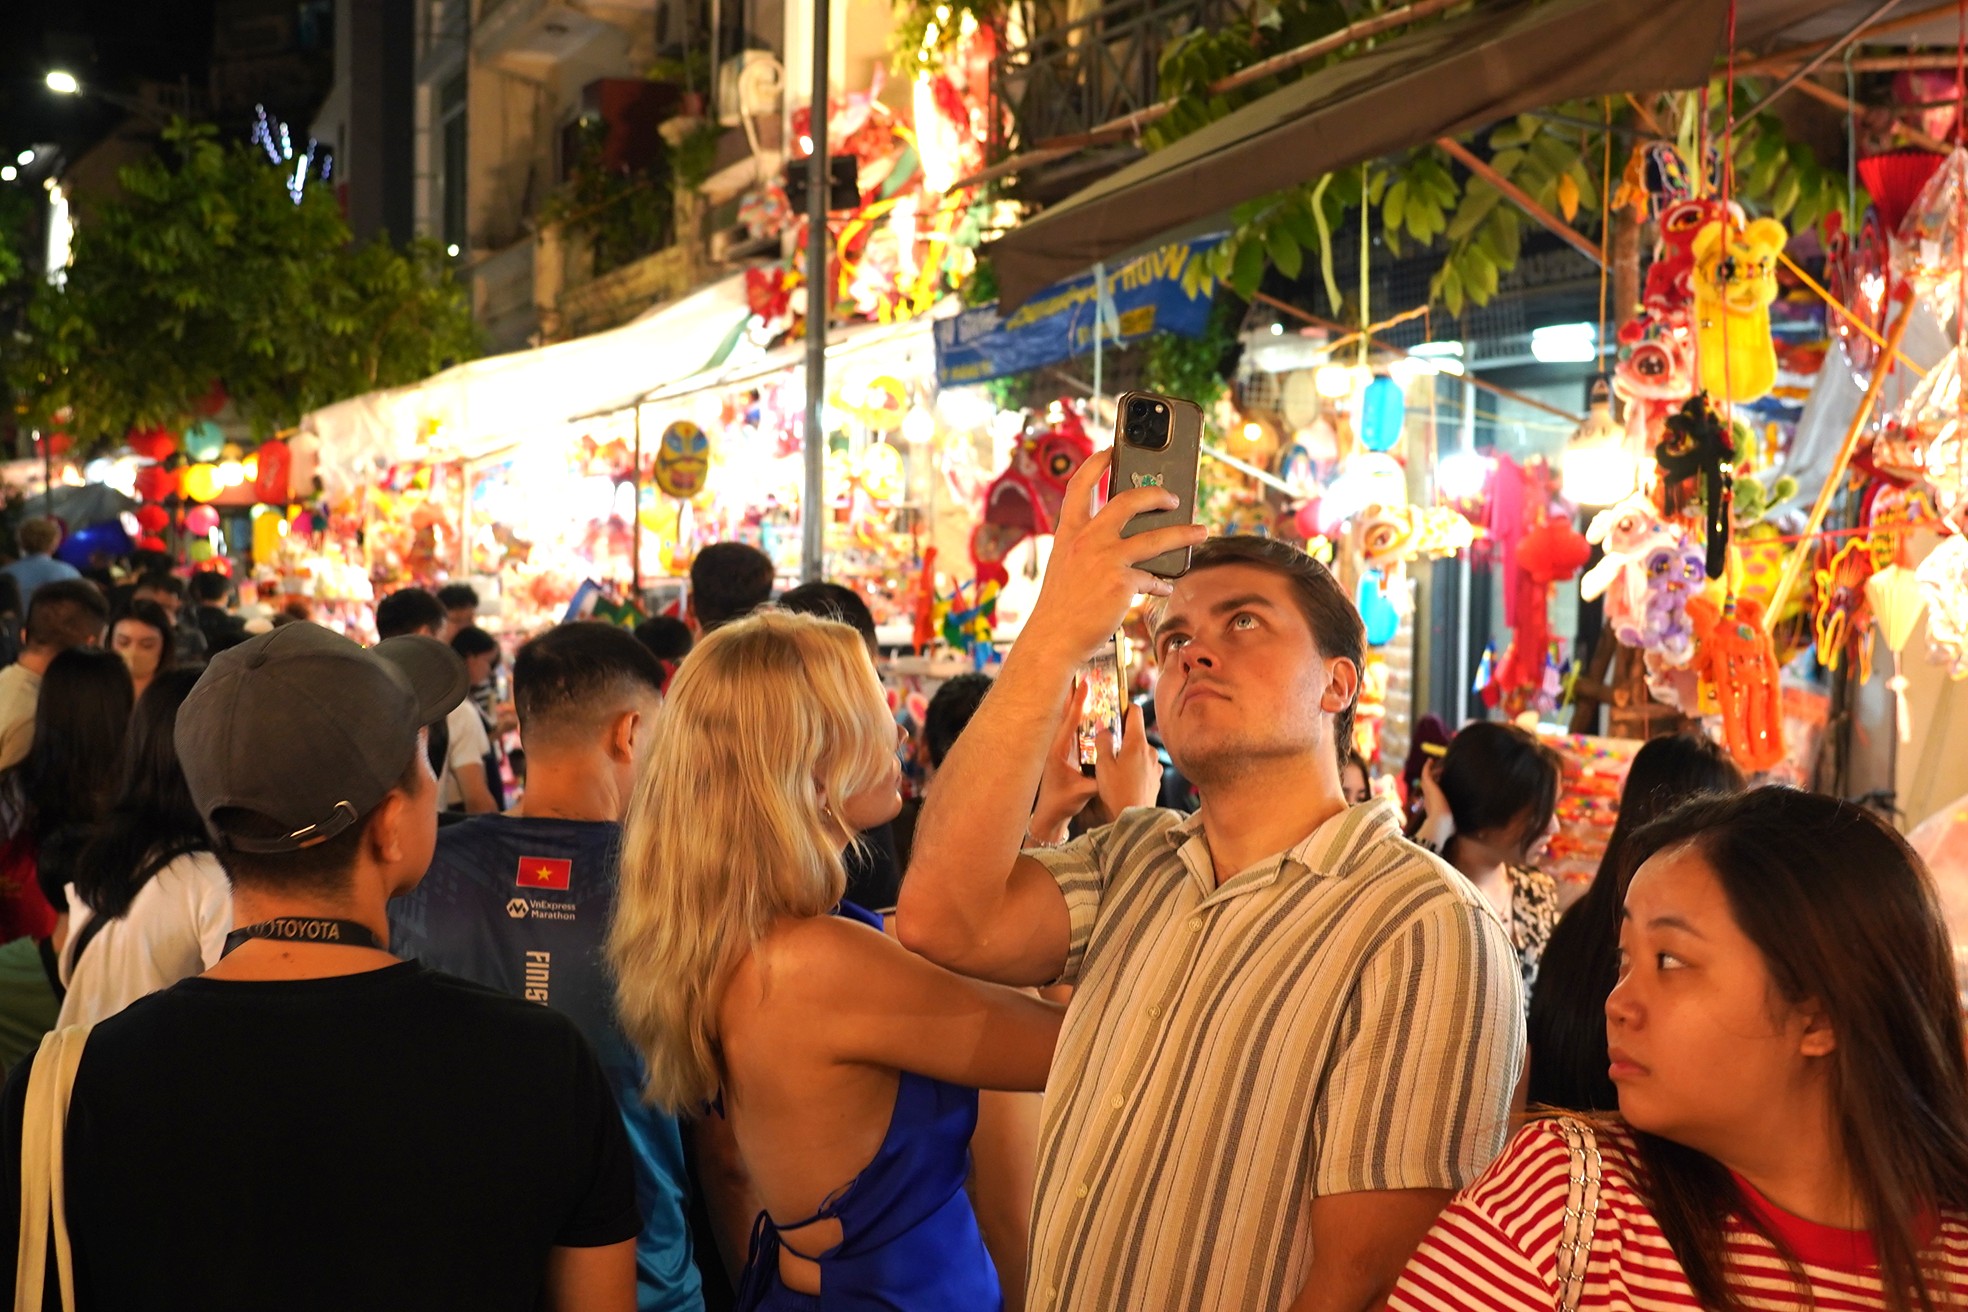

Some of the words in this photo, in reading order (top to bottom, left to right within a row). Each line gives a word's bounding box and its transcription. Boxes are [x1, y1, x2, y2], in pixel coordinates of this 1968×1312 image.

[530, 899, 576, 911] VnExpress
[531, 909, 576, 920] Marathon
[275, 918, 340, 940] TOYOTA
[525, 951, 550, 1006] FINIS
